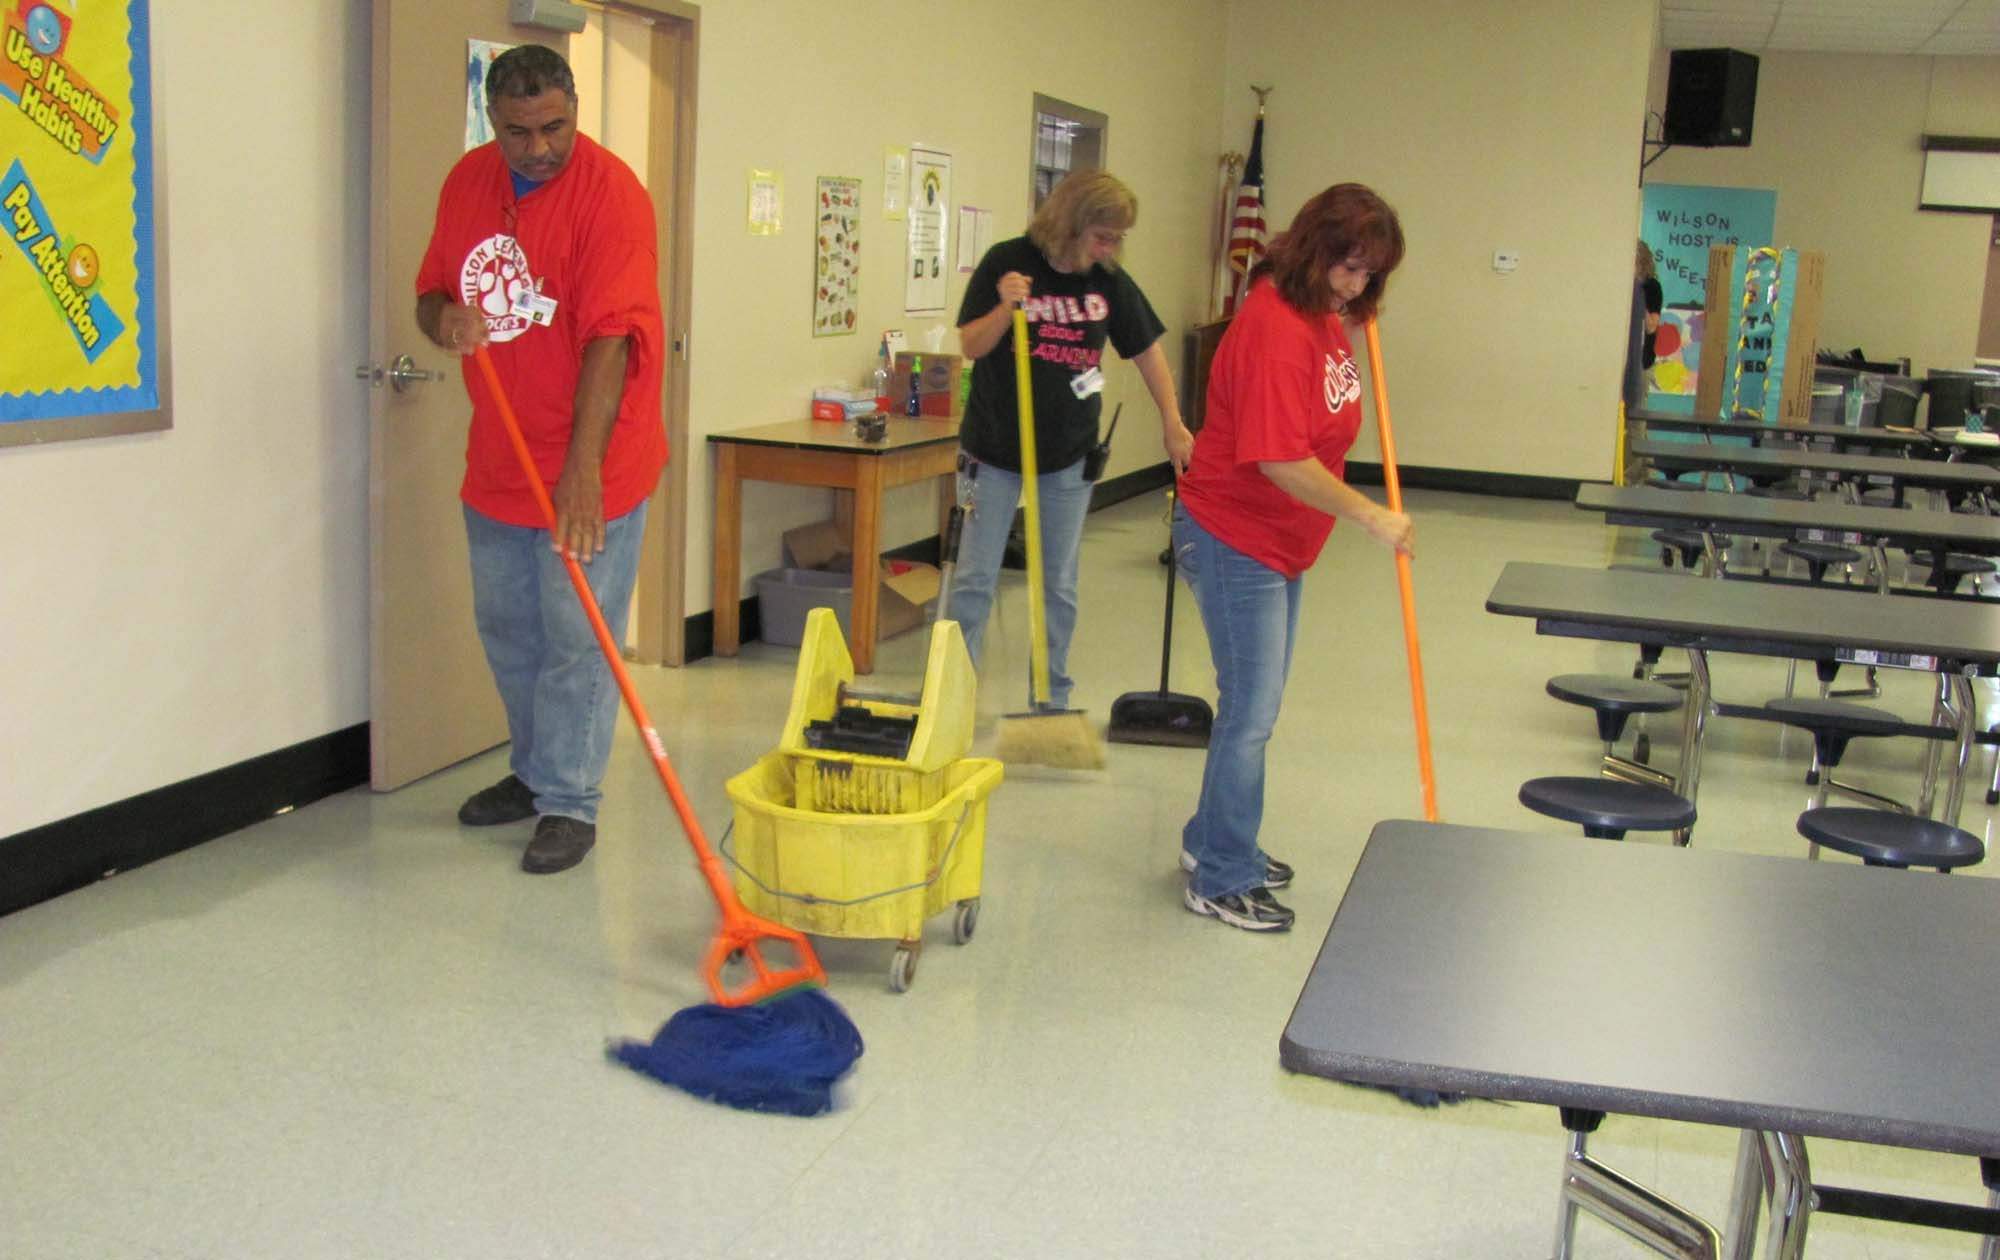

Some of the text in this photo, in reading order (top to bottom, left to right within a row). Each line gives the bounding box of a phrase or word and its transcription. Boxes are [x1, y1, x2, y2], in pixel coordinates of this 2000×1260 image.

[5, 25, 118, 145] Use Healthy
[19, 79, 83, 155] Habits
[1657, 209, 1730, 230] WILSON
[3, 180, 101, 350] Pay Attention
[1655, 248, 1709, 291] SWEET
